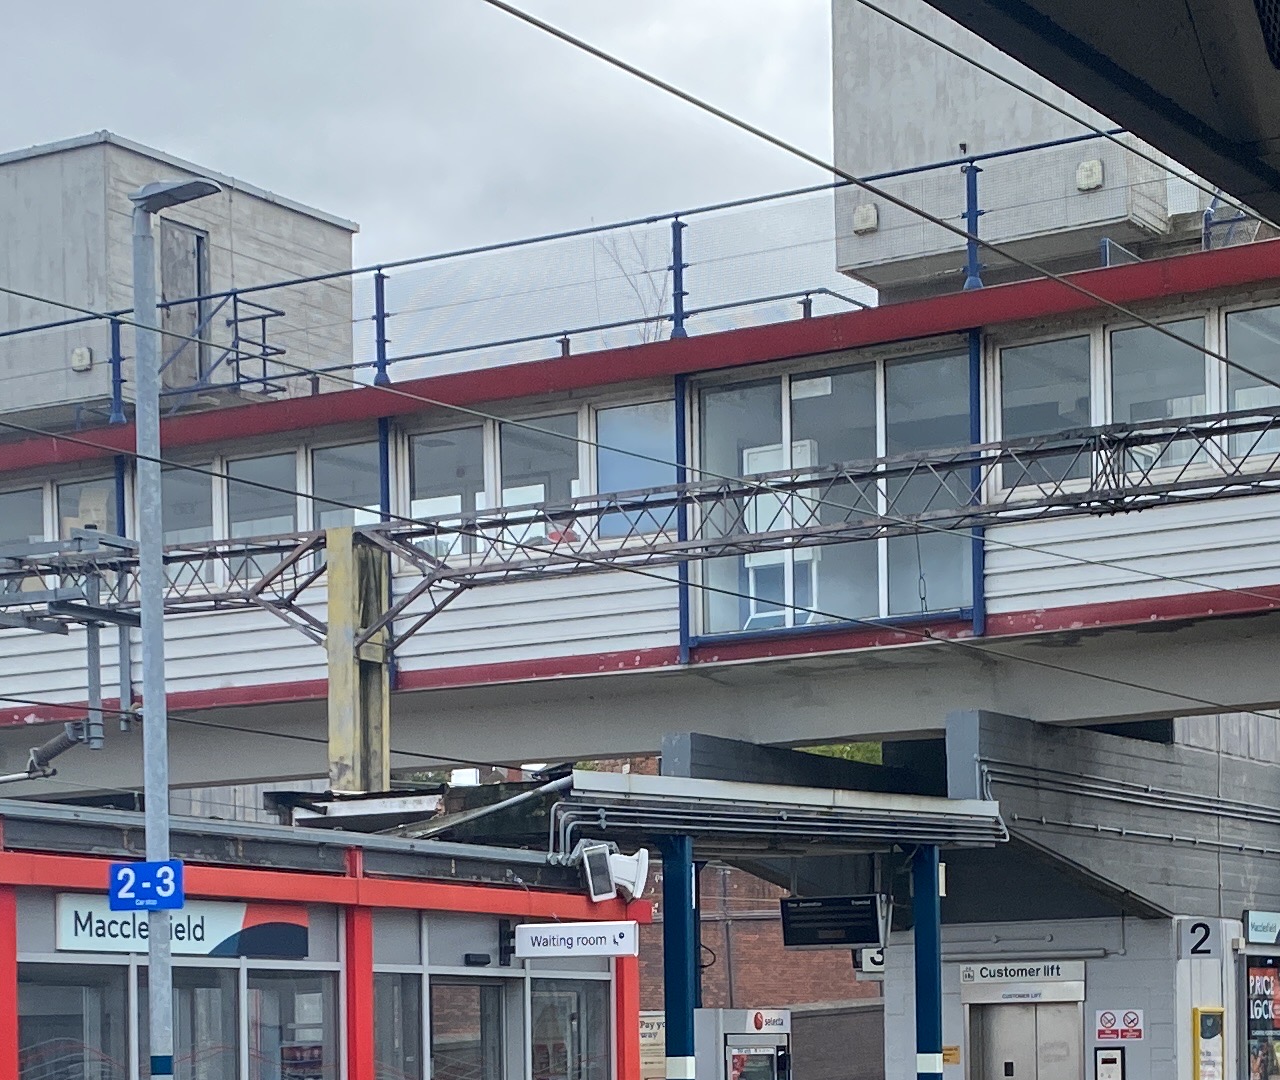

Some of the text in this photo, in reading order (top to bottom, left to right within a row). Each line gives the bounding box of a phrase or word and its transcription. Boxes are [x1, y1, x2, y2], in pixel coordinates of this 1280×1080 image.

[73, 911, 206, 943] Maccleield
[530, 933, 607, 950] Waiting room
[1189, 921, 1212, 955] 2
[979, 964, 1061, 979] Customer lift
[1249, 975, 1275, 995] PRICE
[640, 1020, 655, 1030] Pay
[764, 1016, 784, 1026] selecta
